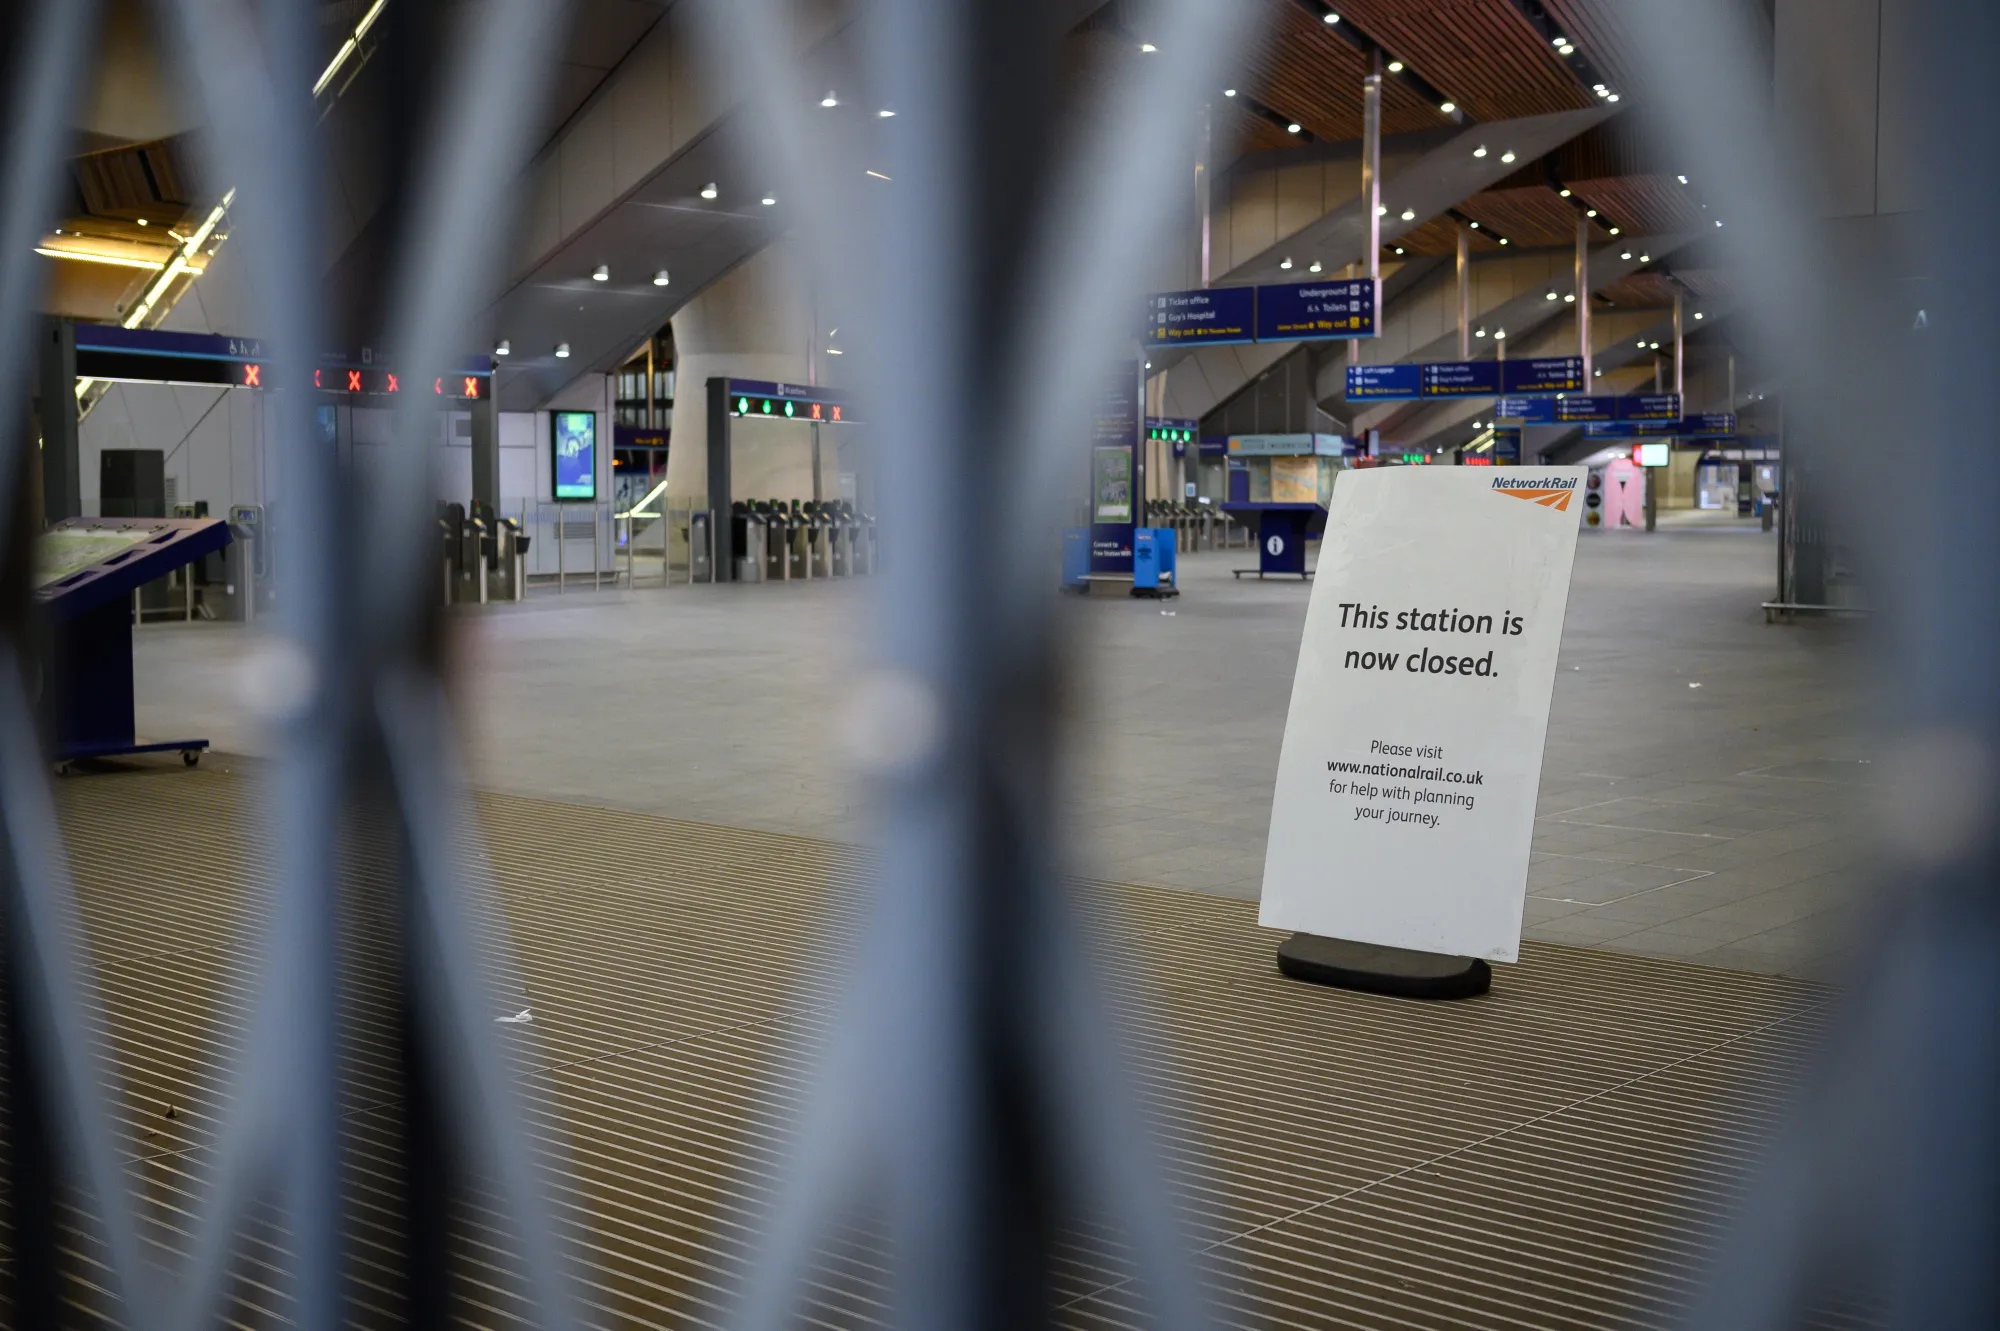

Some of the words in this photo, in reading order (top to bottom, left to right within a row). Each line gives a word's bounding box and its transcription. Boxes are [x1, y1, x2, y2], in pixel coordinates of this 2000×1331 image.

[1168, 297, 1188, 306] Ticket
[1189, 296, 1210, 305] office
[1299, 286, 1348, 298] Underground
[1168, 312, 1186, 323] Guy's
[1187, 310, 1216, 321] Hospital
[1323, 303, 1348, 313] Toilets
[1338, 603, 1389, 630] This
[1396, 607, 1493, 634] station
[1501, 610, 1524, 636] is
[1344, 650, 1400, 671] now
[1406, 647, 1498, 678] closed.
[1370, 739, 1413, 757] Please
[1416, 745, 1444, 760] visit
[1327, 760, 1484, 786] www.nationalrail.co.uk
[1329, 778, 1347, 794] for
[1350, 781, 1379, 800] help
[1382, 785, 1410, 800] with
[1413, 788, 1475, 811] planning
[1353, 806, 1385, 821] your
[1385, 807, 1441, 829] journey.
